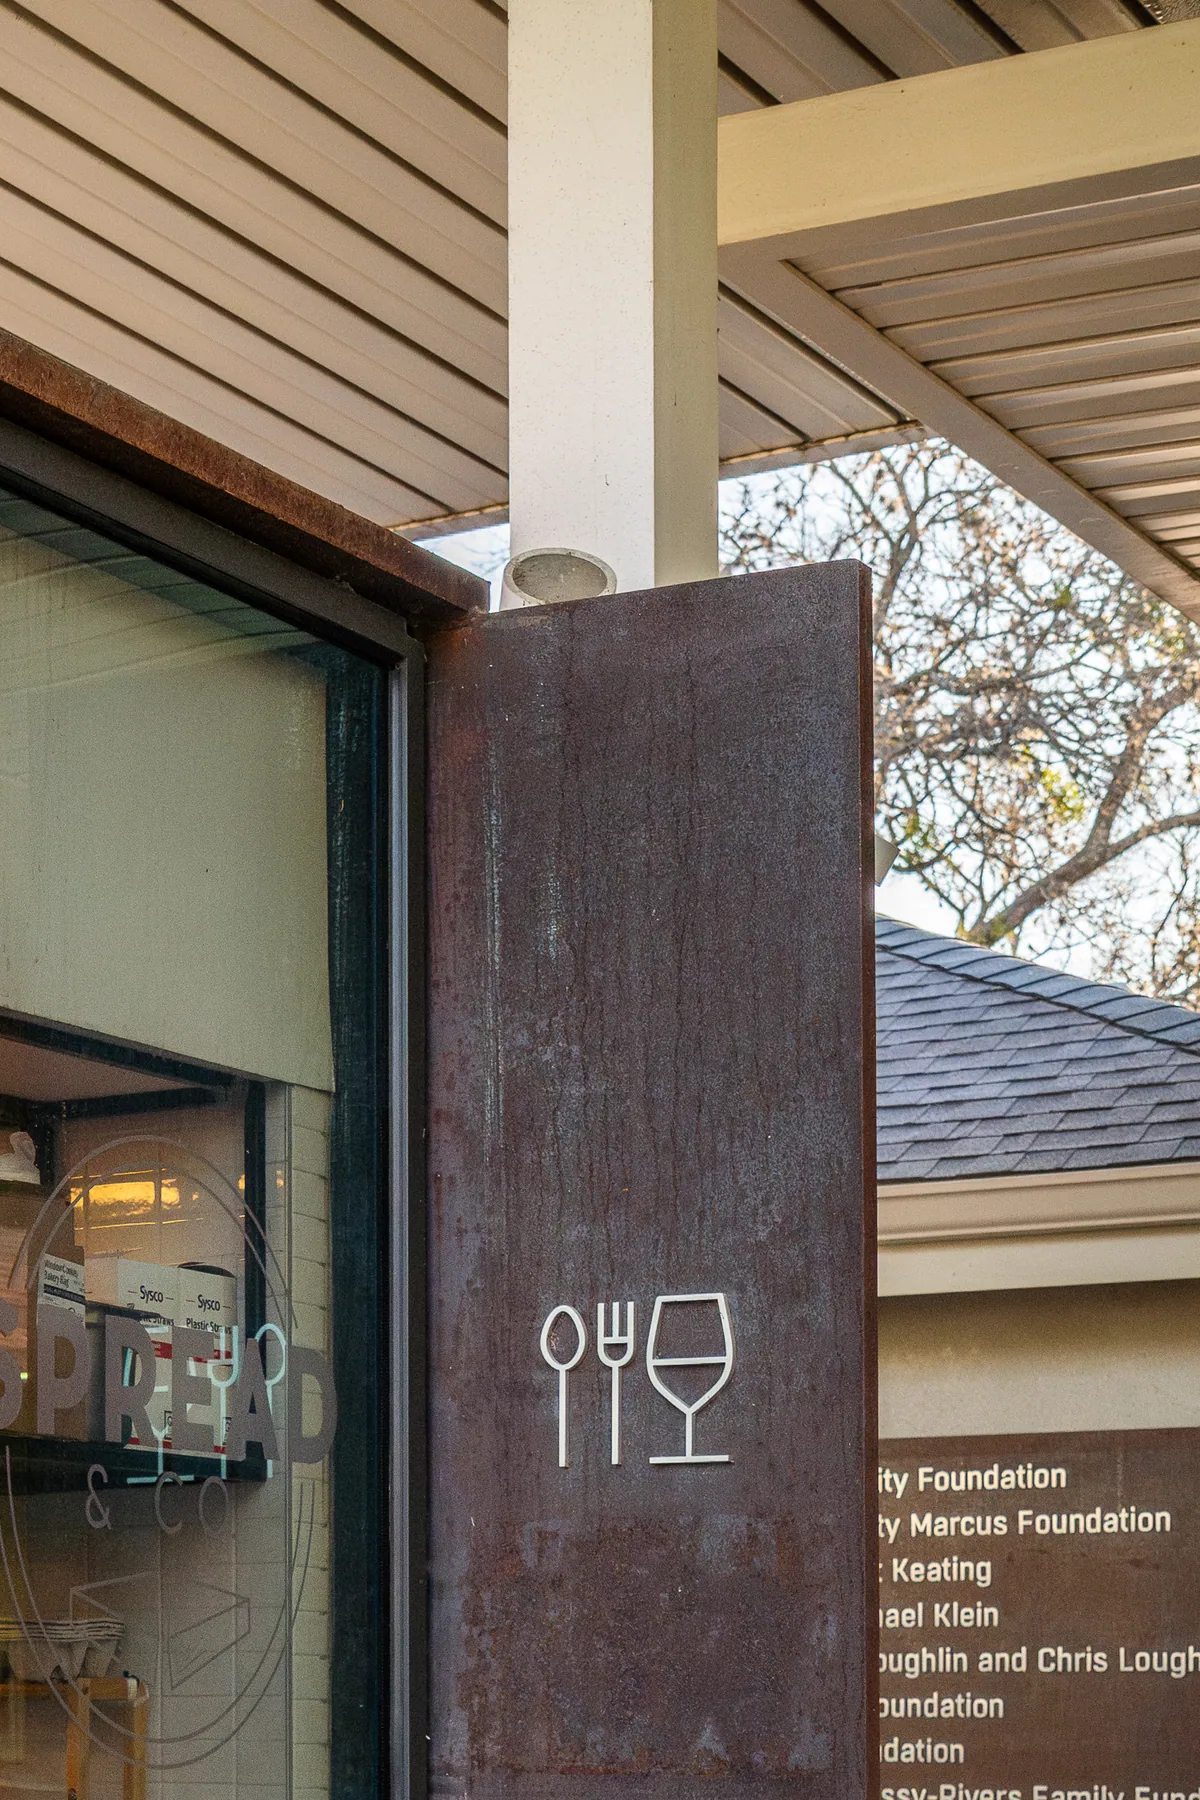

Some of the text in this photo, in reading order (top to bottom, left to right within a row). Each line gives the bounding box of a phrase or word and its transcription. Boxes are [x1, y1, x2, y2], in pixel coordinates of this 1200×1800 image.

[140, 1285, 164, 1304] Sysco
[197, 1294, 221, 1312] Sysco
[186, 1317, 209, 1329] Plastic
[879, 1463, 1067, 1497] ity Foundation
[85, 1463, 229, 1539] & CO
[910, 1513, 1008, 1537] Marcus
[1018, 1506, 1171, 1535] Foundation
[892, 1556, 992, 1587] Keating
[933, 1601, 999, 1628] Klein
[978, 1646, 1027, 1673] and
[1037, 1646, 1108, 1673] Chris
[1119, 1646, 1200, 1679] Lough
[879, 1737, 964, 1764] dation
